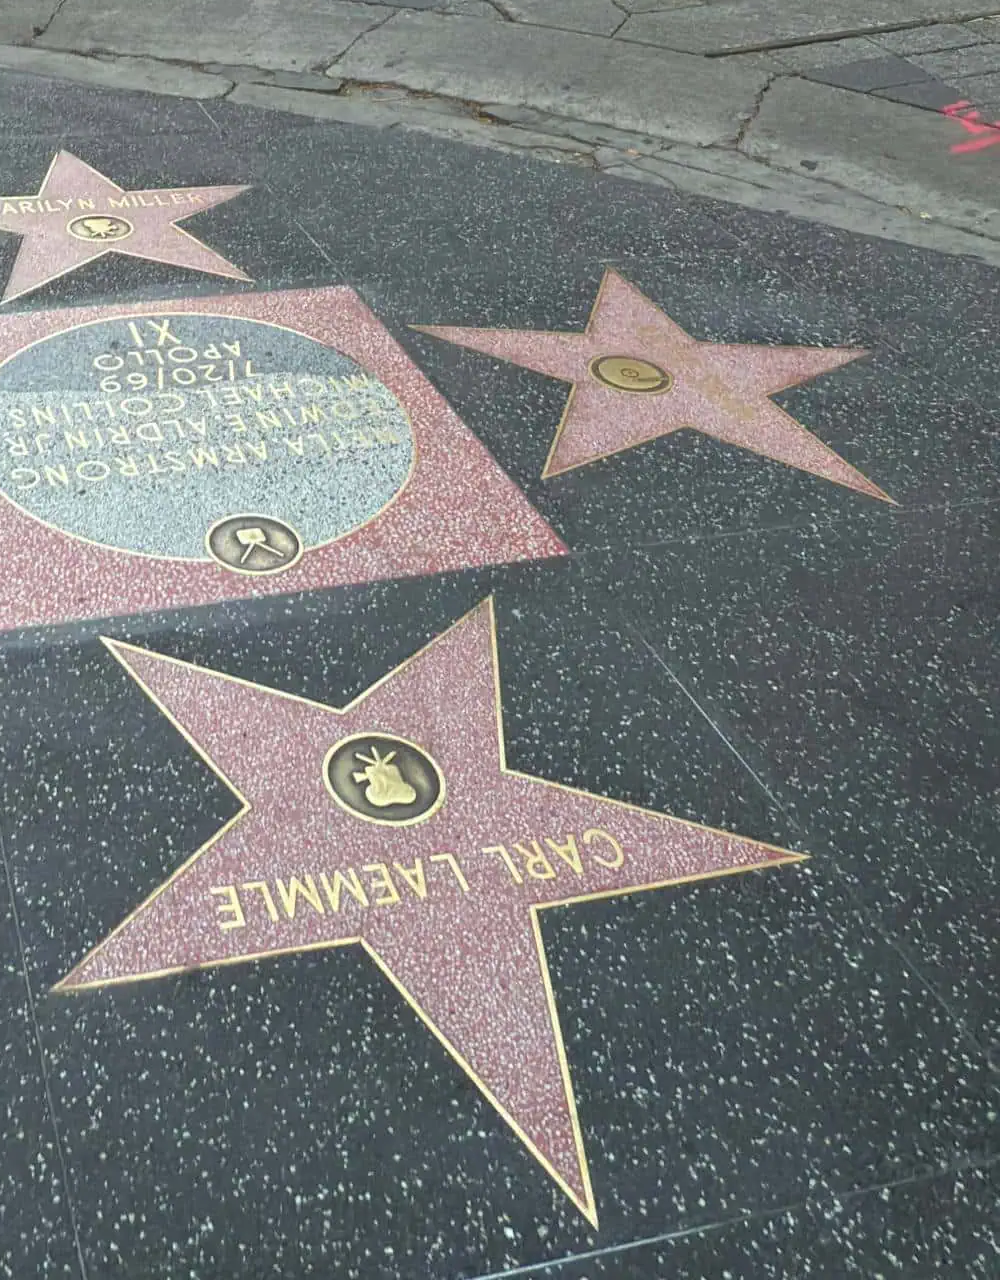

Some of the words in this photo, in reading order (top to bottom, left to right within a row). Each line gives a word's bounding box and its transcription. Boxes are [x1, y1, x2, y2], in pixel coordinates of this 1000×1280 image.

[108, 193, 204, 209] MILLER
[128, 319, 182, 348] XI
[93, 340, 241, 370] APOLLO
[196, 372, 371, 408] MICHAEL
[8, 393, 186, 429] COLLINS
[64, 418, 207, 450] ALDRIN
[10, 440, 269, 490] ARMSTRONG
[482, 827, 626, 885] CARL
[211, 853, 471, 930] LAEMMLE
